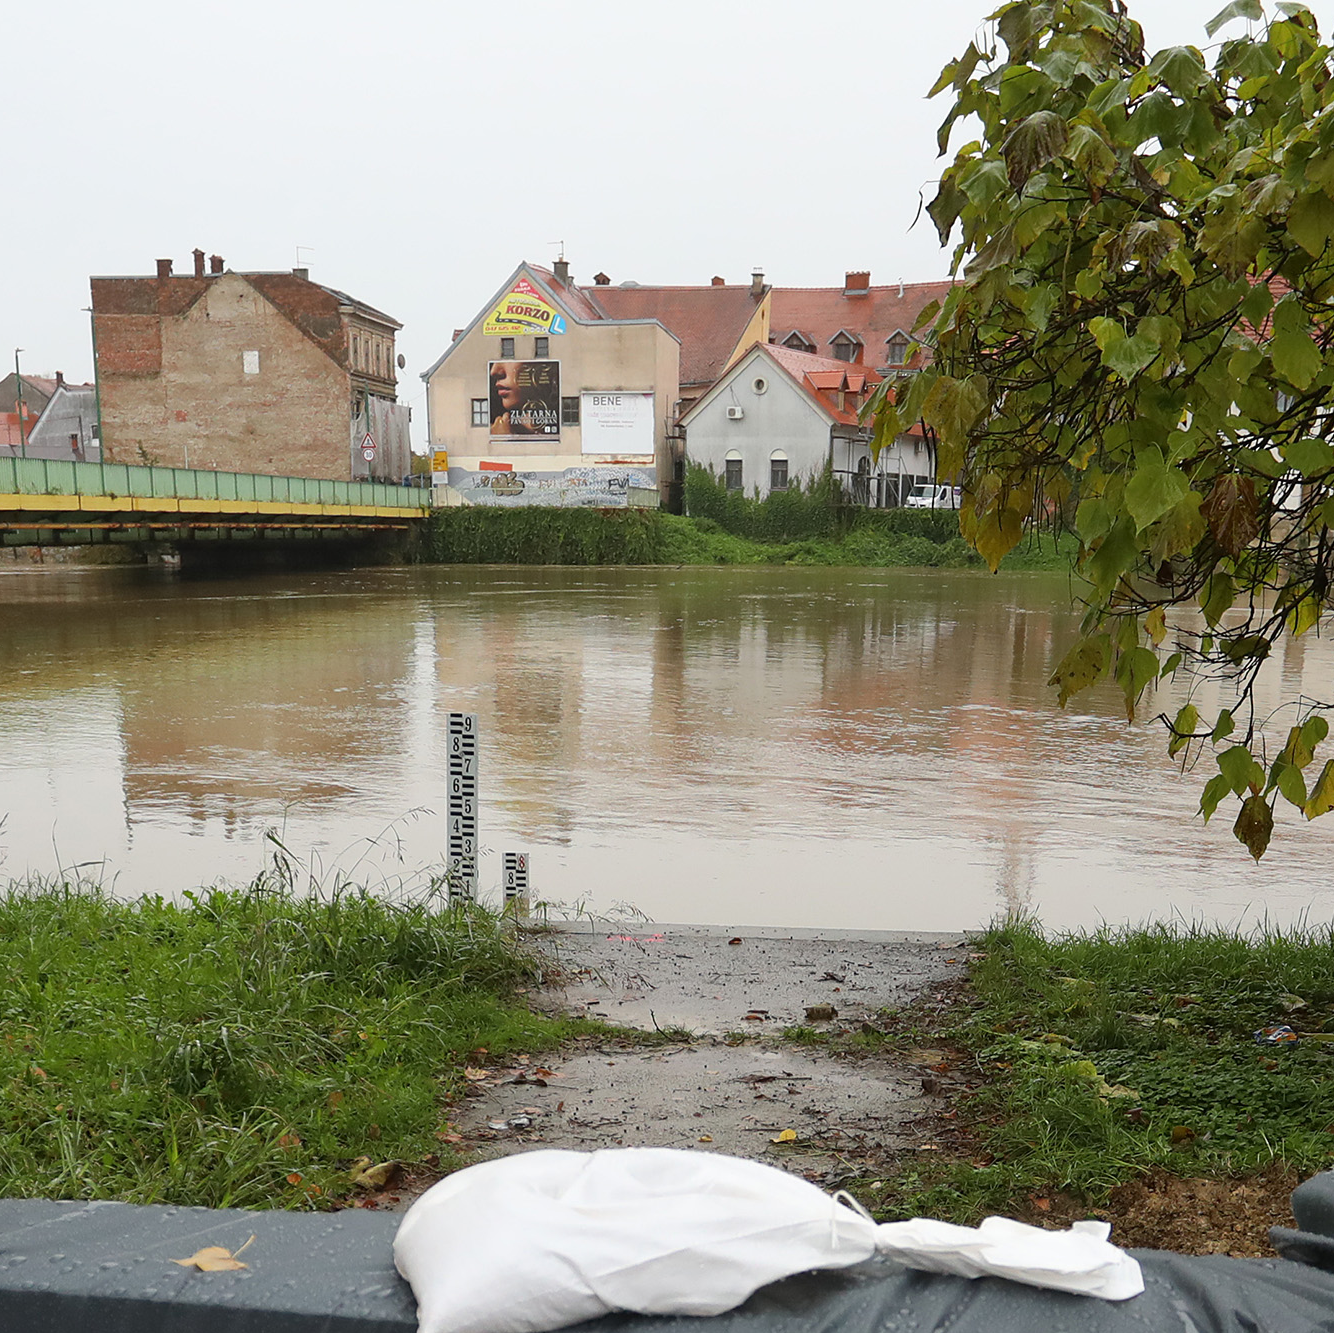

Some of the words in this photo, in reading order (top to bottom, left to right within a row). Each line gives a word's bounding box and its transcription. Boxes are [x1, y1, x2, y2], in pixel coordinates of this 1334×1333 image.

[505, 305, 550, 321] KORZO
[592, 396, 622, 406] BENE
[510, 410, 557, 418] ZLATARNA
[464, 716, 472, 732] 9
[452, 736, 460, 752] 8
[464, 758, 471, 773] 7
[452, 777, 460, 793] 6
[464, 799, 472, 814] 5
[452, 818, 460, 834] 4
[464, 839, 472, 854] 3
[508, 871, 514, 885] 8
